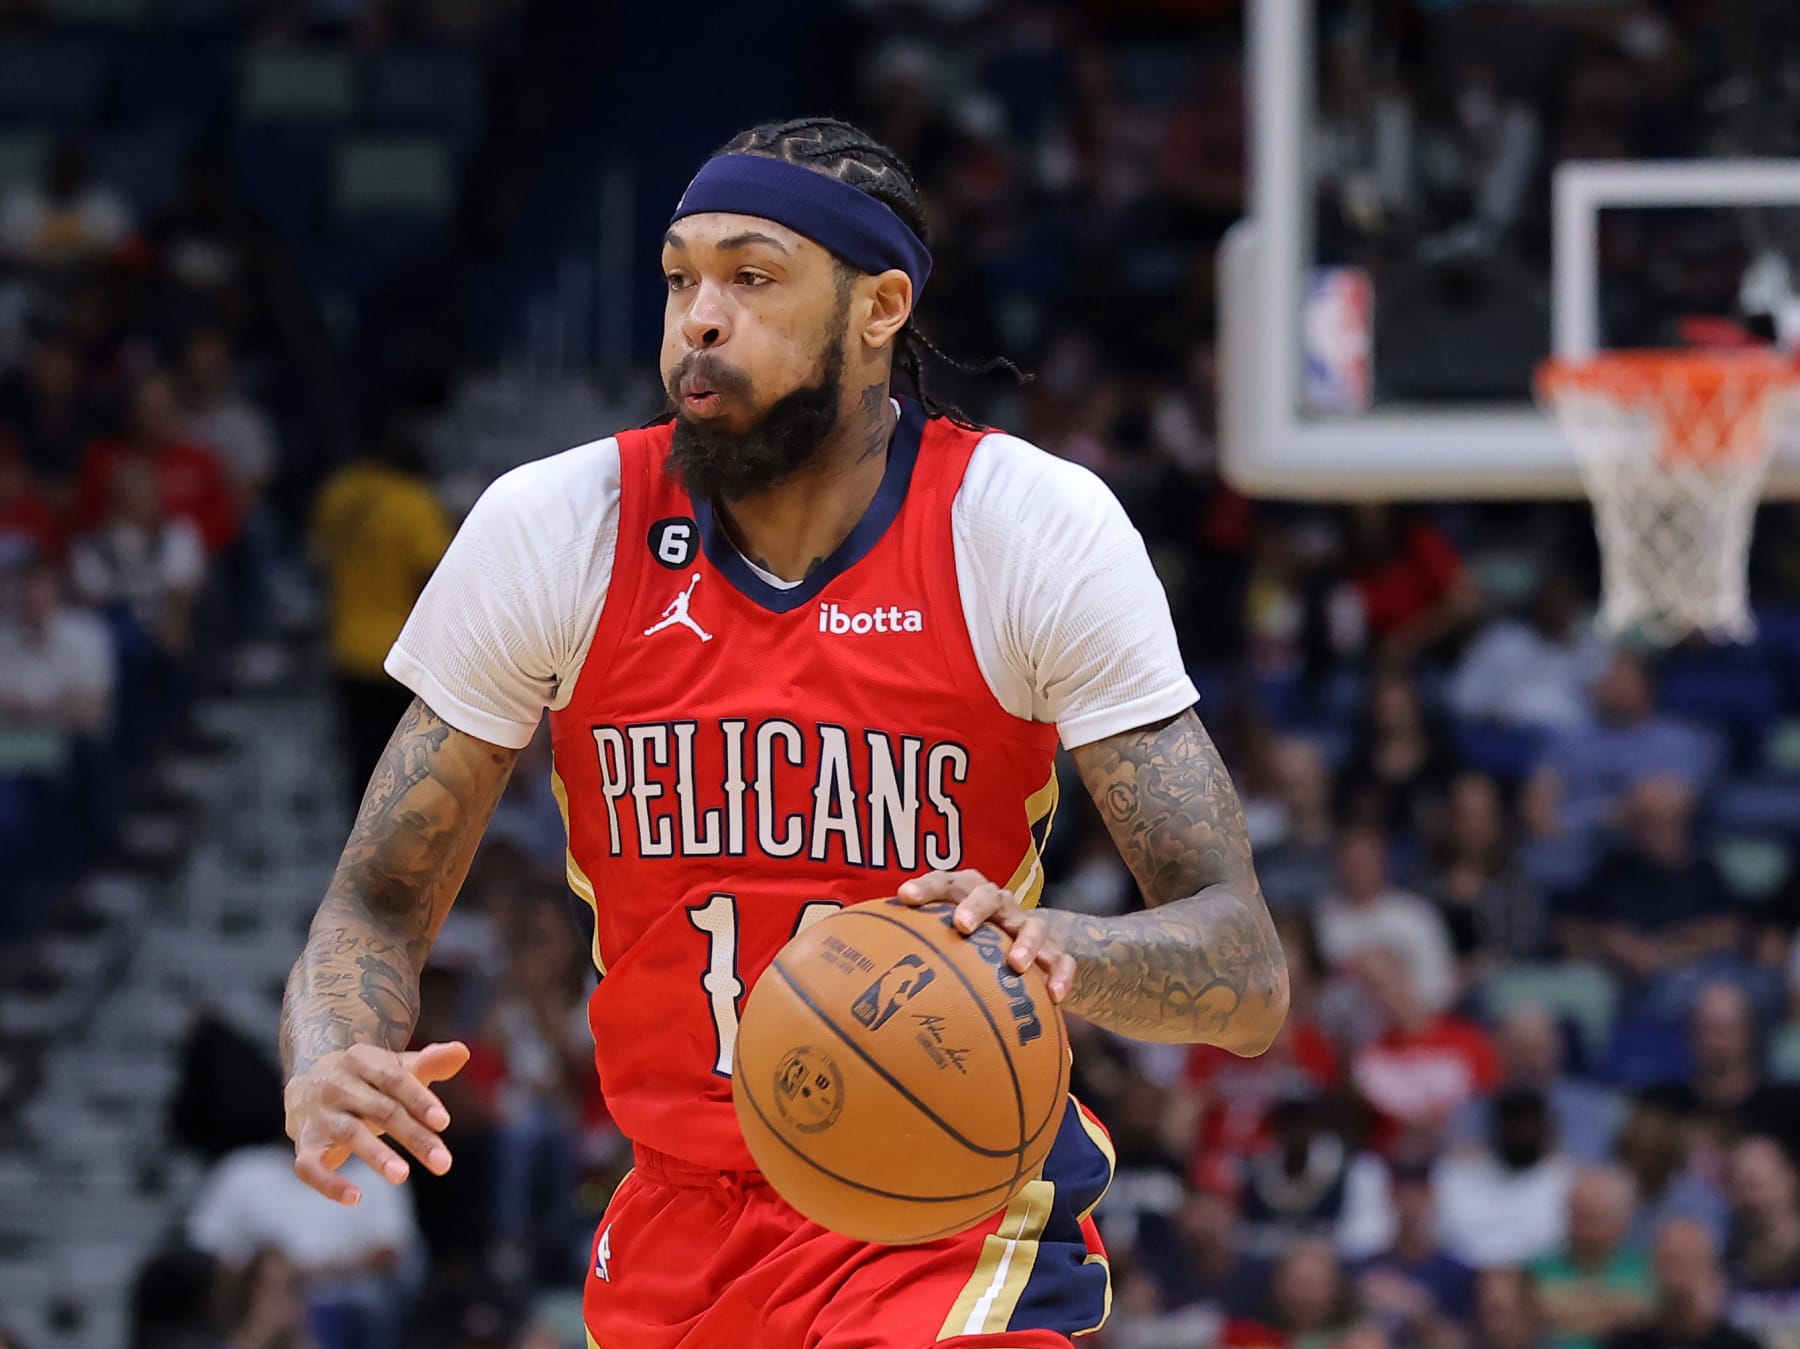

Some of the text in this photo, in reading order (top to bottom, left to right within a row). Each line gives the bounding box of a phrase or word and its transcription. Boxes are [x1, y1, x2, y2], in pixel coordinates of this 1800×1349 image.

[658, 524, 690, 564] 6
[819, 602, 923, 635] ibotta
[592, 717, 969, 872] PELICANS
